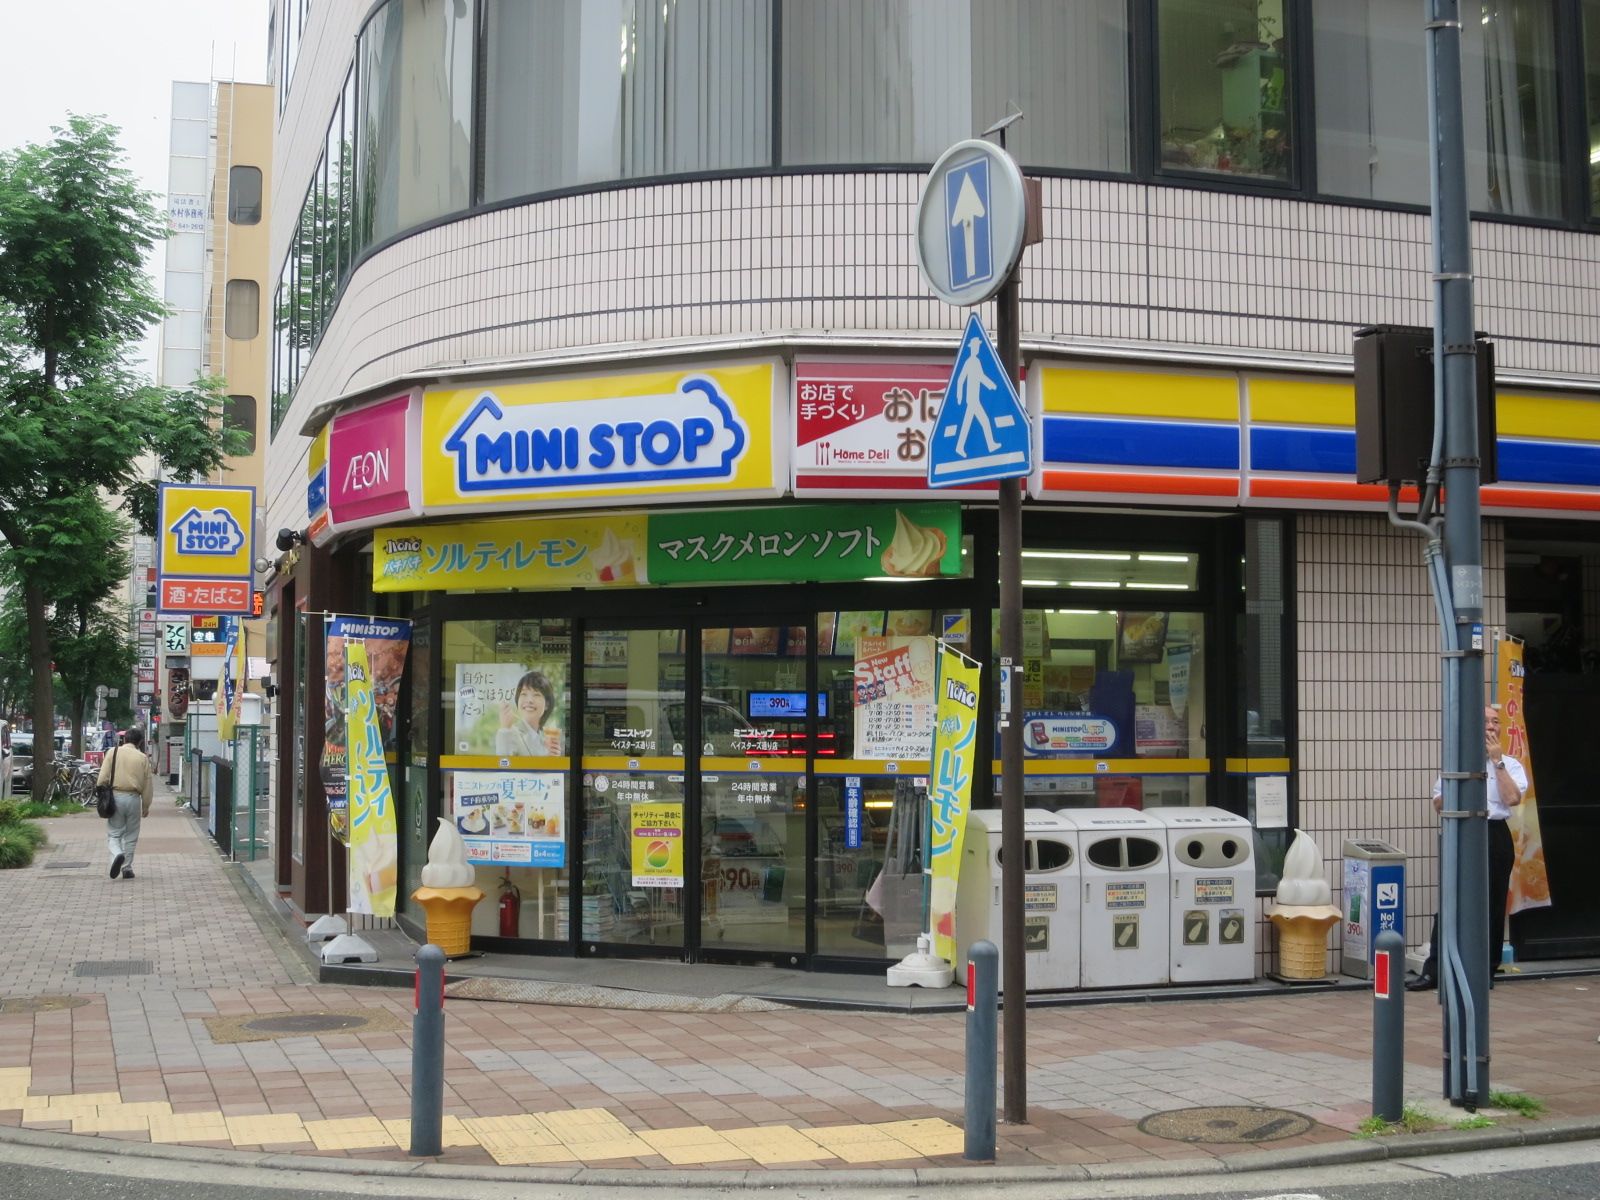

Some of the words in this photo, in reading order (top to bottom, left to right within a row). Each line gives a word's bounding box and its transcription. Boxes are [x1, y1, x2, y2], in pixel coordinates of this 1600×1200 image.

[800, 383, 854, 401] お店で
[800, 402, 866, 421] 手づくり
[475, 425, 579, 476] MINI
[589, 417, 715, 469] STOP
[833, 449, 865, 461] Home
[868, 449, 890, 460] Deli
[188, 520, 228, 535] MINI
[185, 535, 231, 550] STOP
[658, 525, 881, 563] マスクメロンソフト
[426, 539, 588, 574] ソルティレモン
[340, 622, 399, 636] MINISTOP
[462, 671, 496, 685] 自分に
[477, 687, 516, 701] ごほうび
[613, 728, 654, 738] ミニストップ
[733, 728, 776, 739] ミニストップ
[610, 740, 656, 750] ベイスターズ通り店
[730, 740, 779, 751] ベイスターズ通り店
[611, 780, 655, 790] 24時間営業
[731, 782, 778, 793] 24時間営業
[616, 792, 649, 801] 年中無休
[737, 794, 772, 804] 年中無休
[1380, 912, 1395, 921] No!
